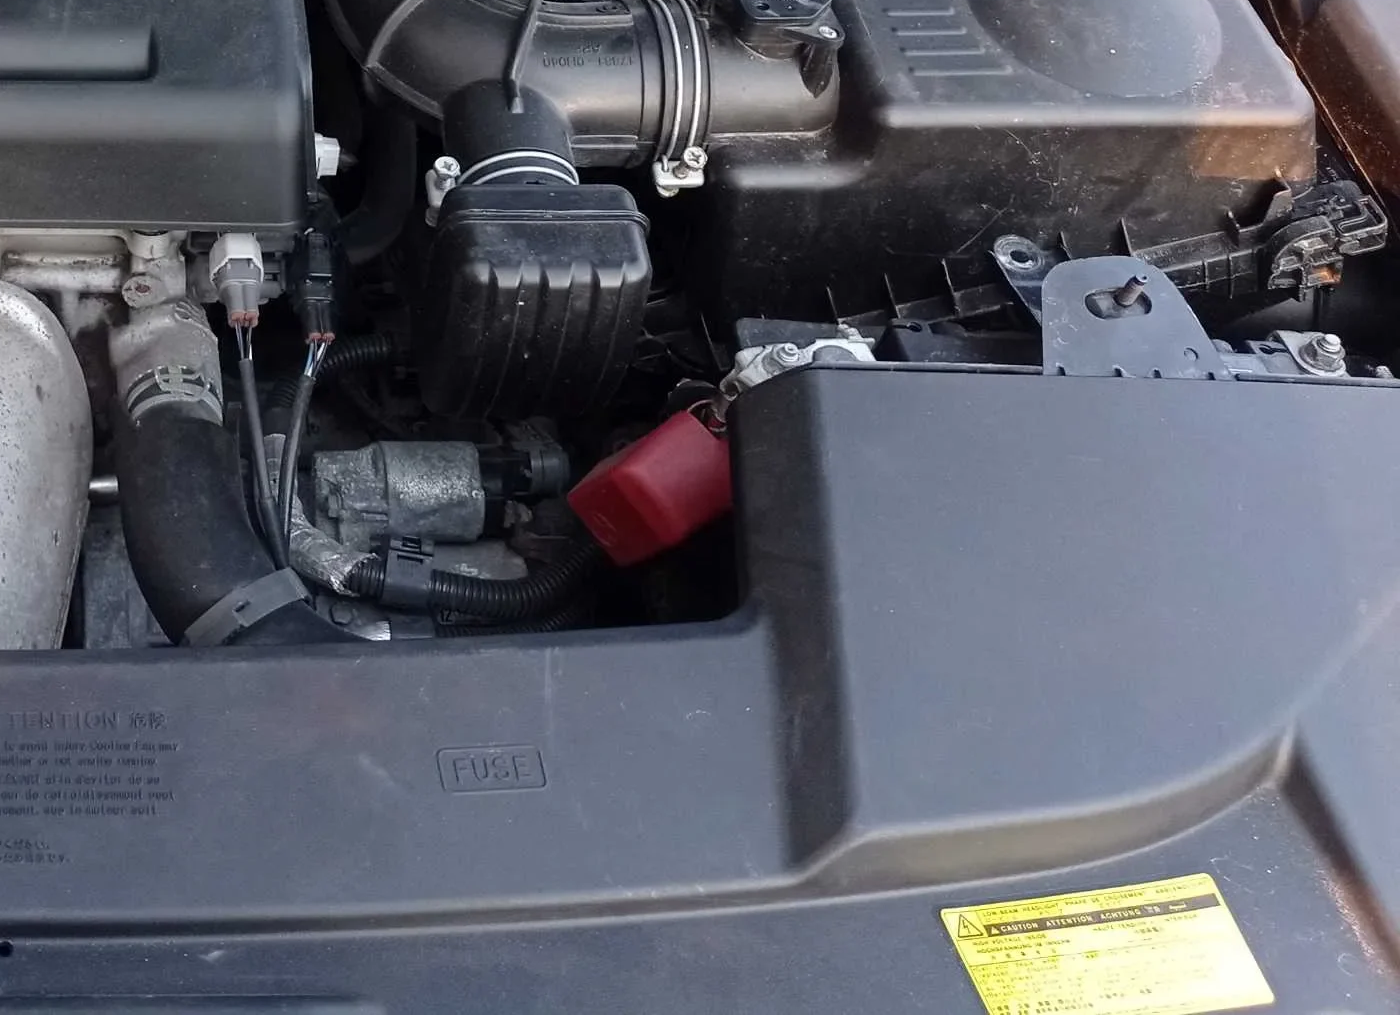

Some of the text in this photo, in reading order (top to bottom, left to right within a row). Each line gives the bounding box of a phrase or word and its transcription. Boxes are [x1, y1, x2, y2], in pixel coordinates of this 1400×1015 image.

[453, 755, 531, 783] FUSE
[1000, 922, 1039, 933] CAUTION
[1045, 915, 1094, 928] ATTENTION
